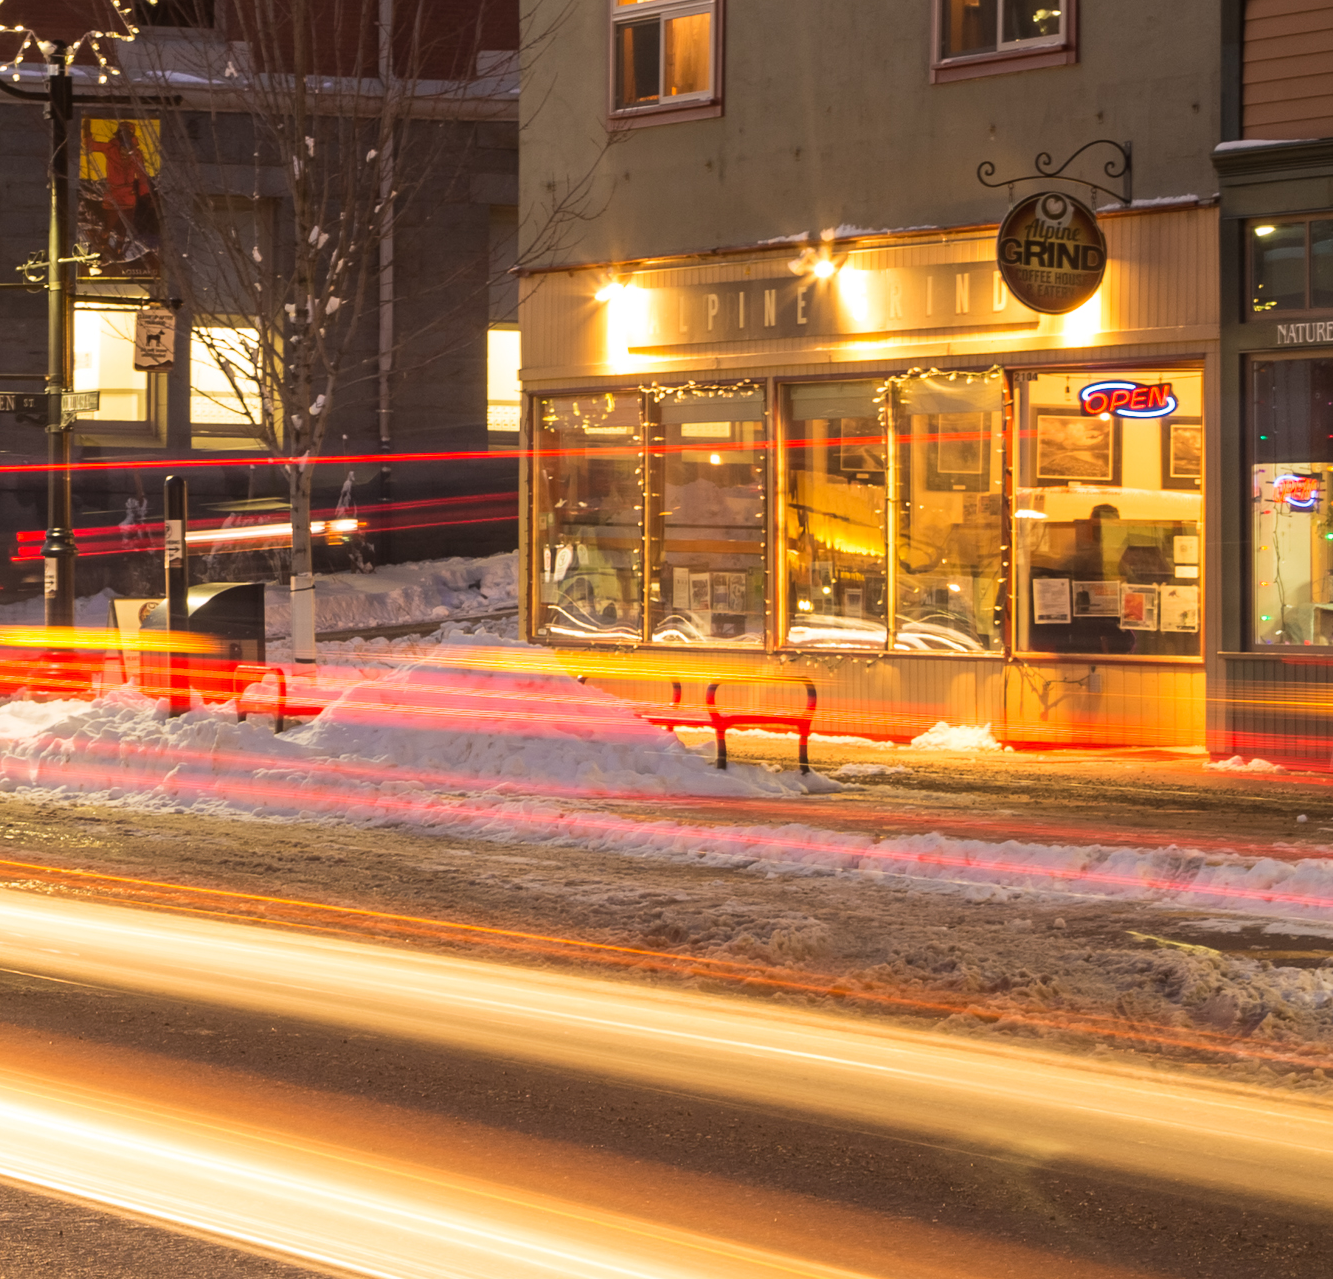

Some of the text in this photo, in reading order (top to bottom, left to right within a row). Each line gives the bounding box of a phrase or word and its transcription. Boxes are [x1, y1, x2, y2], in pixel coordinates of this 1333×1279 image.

[1025, 219, 1081, 242] Alpine
[999, 238, 1105, 271] GRIND
[1016, 268, 1087, 287] COFFEE HOUS
[853, 270, 1008, 320] RIND
[1277, 322, 1333, 344] NATURE
[1084, 384, 1170, 414] OPEN
